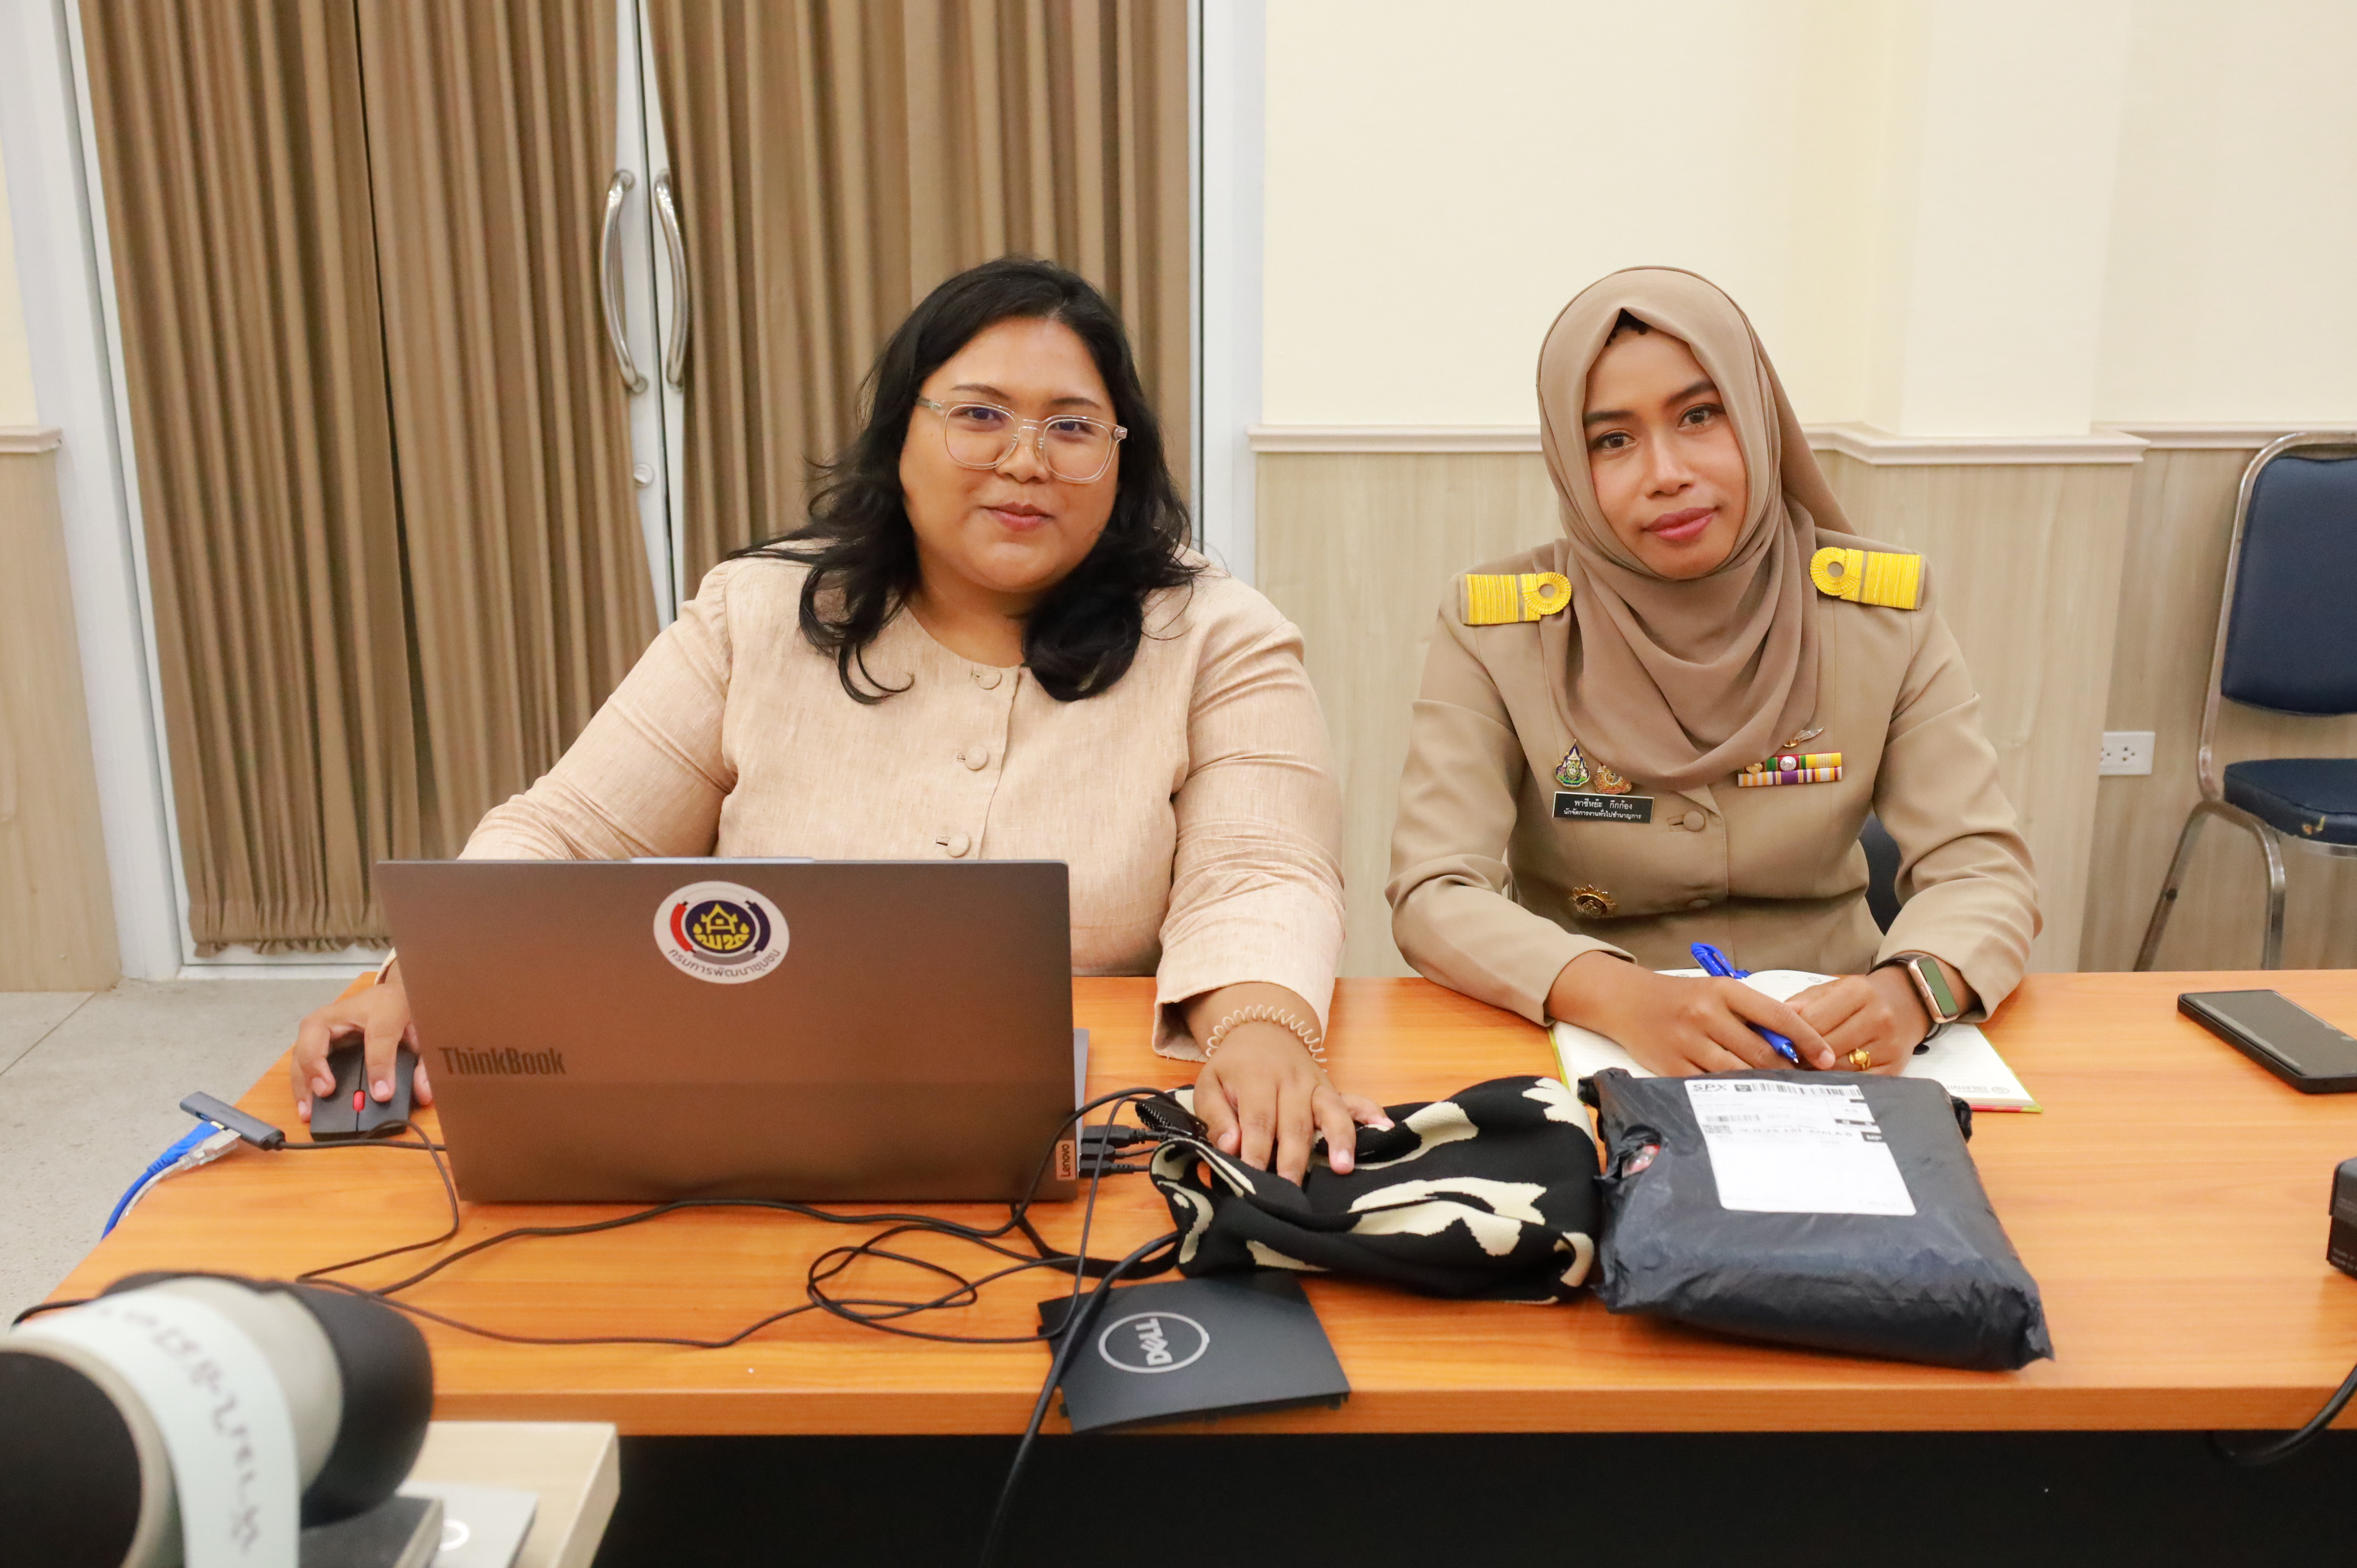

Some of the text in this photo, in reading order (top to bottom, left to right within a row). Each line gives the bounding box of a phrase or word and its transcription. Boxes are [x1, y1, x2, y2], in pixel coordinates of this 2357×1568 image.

[1563, 808, 1642, 820] นักจัดการงานทั่วไปชำนาญการ
[668, 948, 781, 978] กรมการพัฒนาชุมชน
[438, 1047, 567, 1075] ThinkBook
[1061, 1143, 1071, 1177] Lenovo
[1135, 1318, 1173, 1366] DELL
